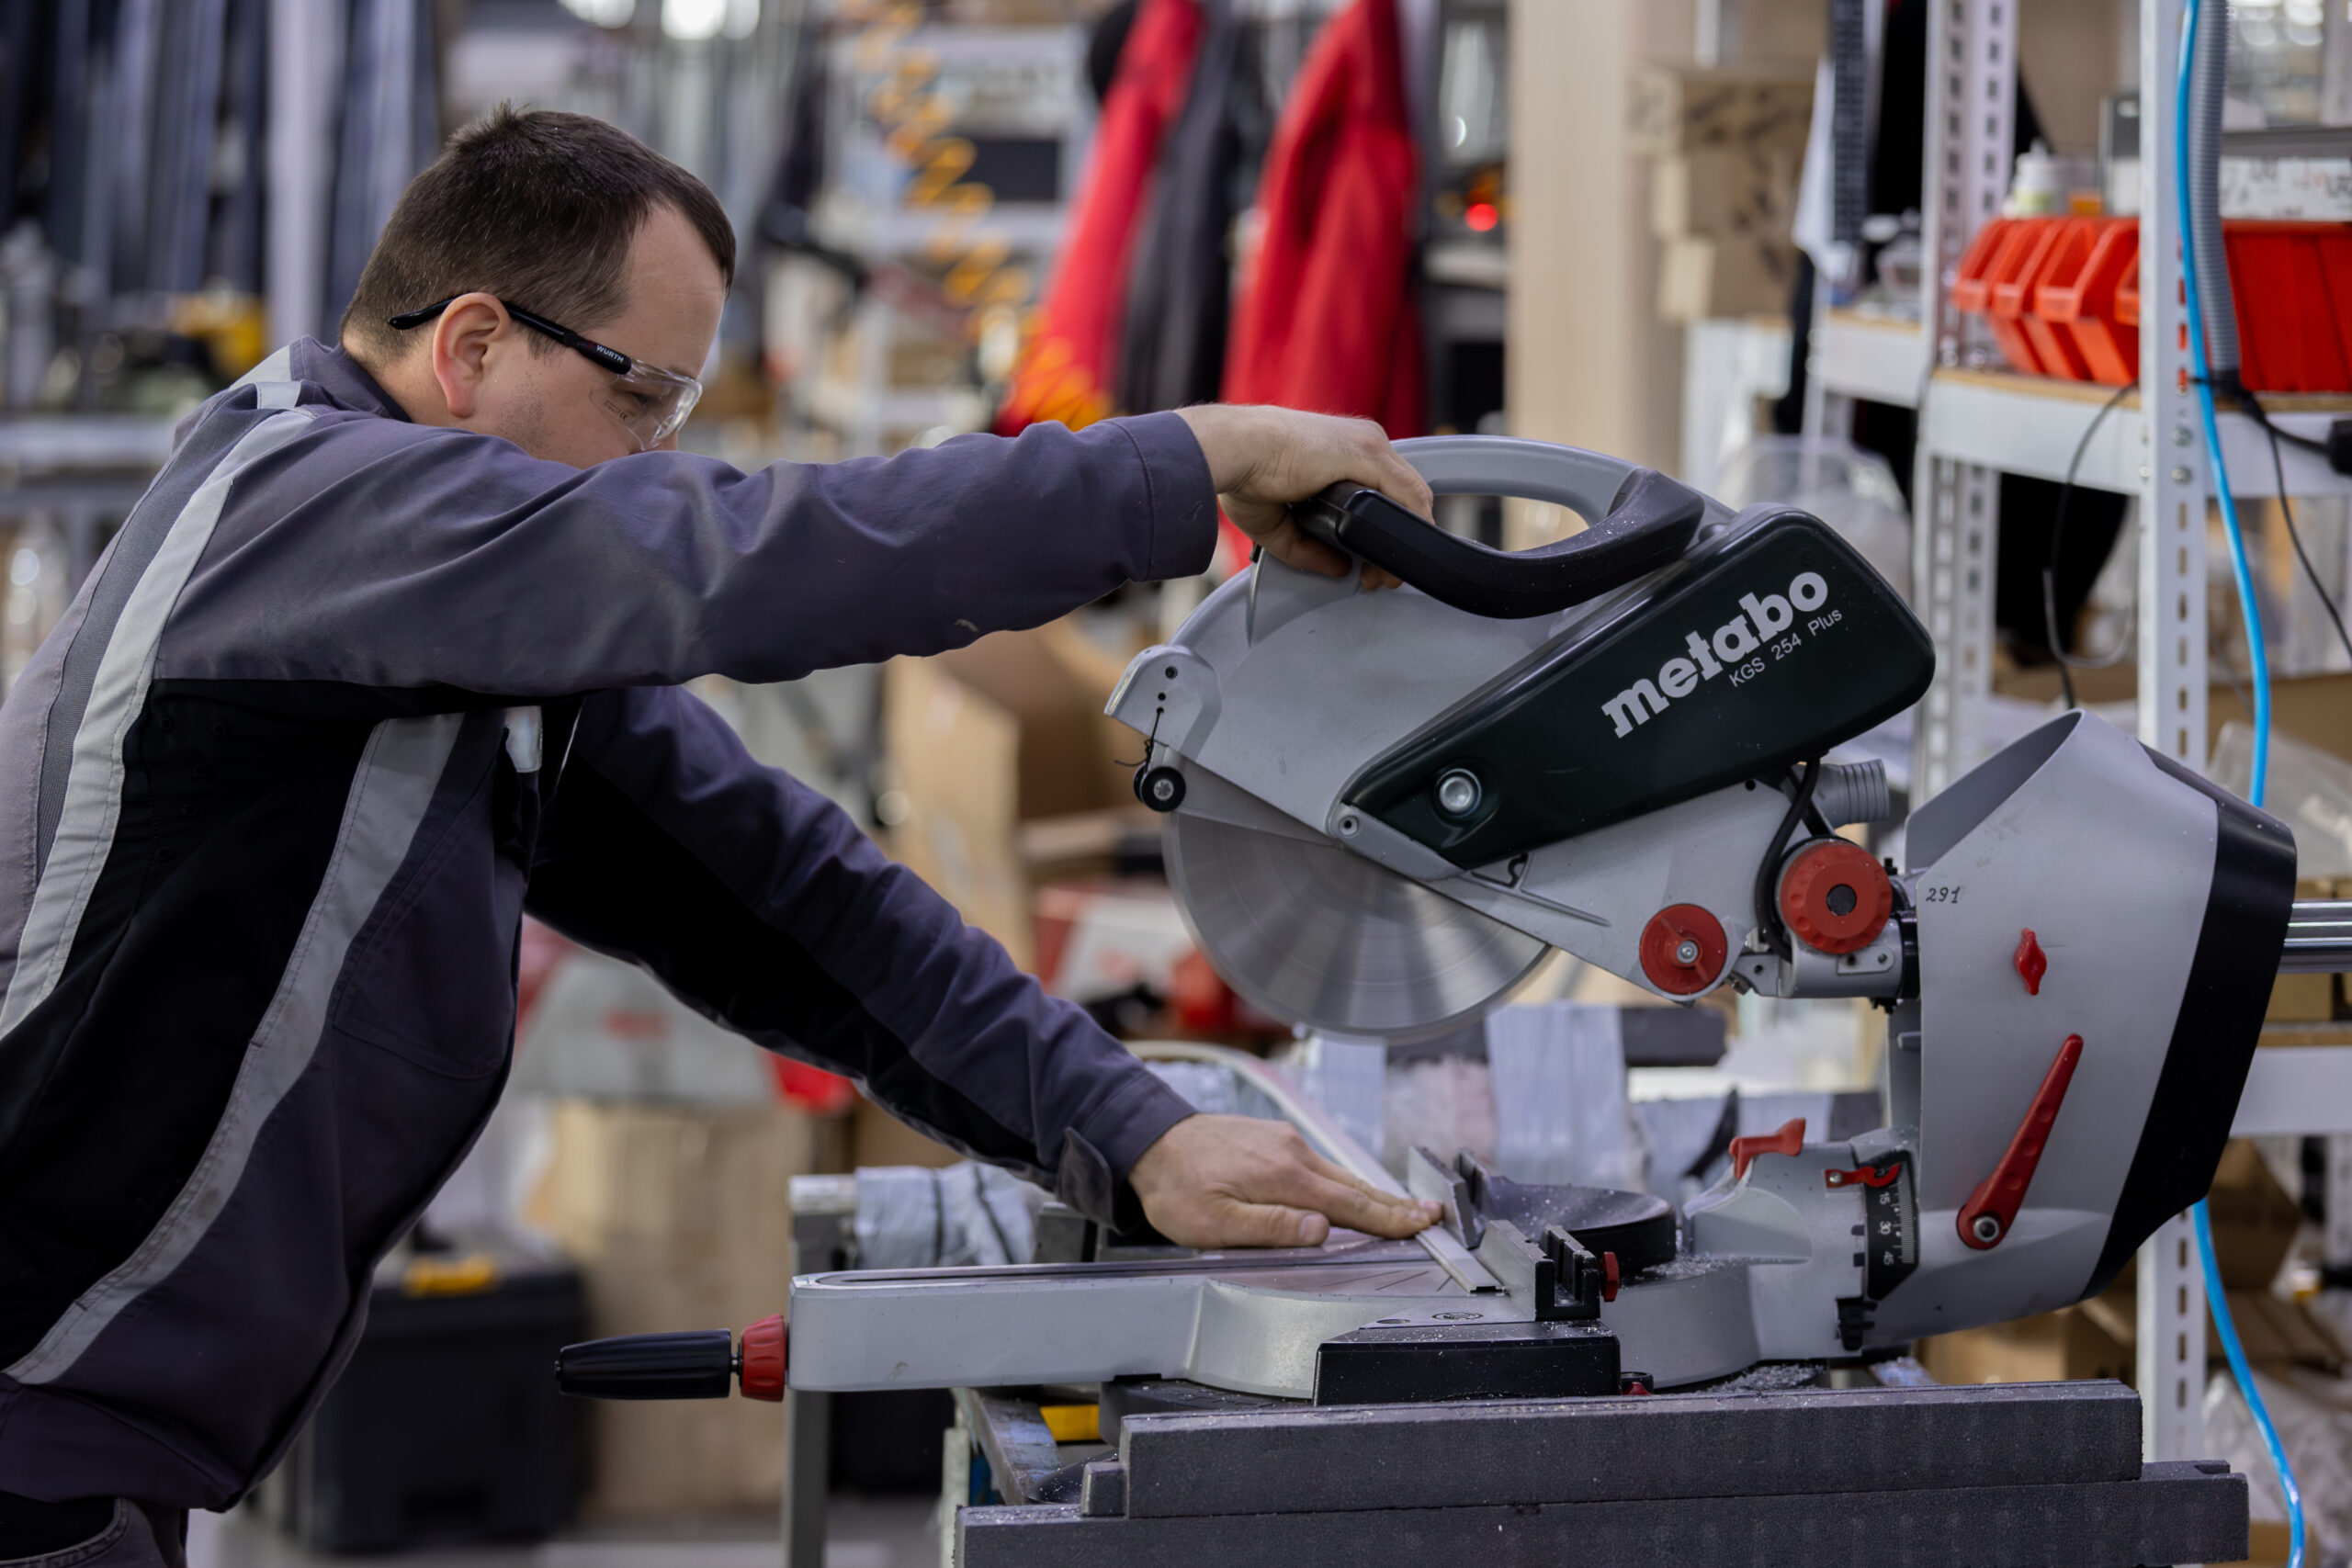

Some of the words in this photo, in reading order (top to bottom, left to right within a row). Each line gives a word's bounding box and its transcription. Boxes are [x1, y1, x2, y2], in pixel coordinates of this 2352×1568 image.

[1601, 571, 1828, 739] metabo
[1728, 657, 1766, 687] KGS
[1770, 632, 1803, 660] 254
[1807, 610, 1843, 636] Plus
[1925, 886, 1961, 904] 291
[1879, 1191, 1891, 1204] 15
[1880, 1221, 1892, 1235] 30
[1883, 1250, 1894, 1266] 45
